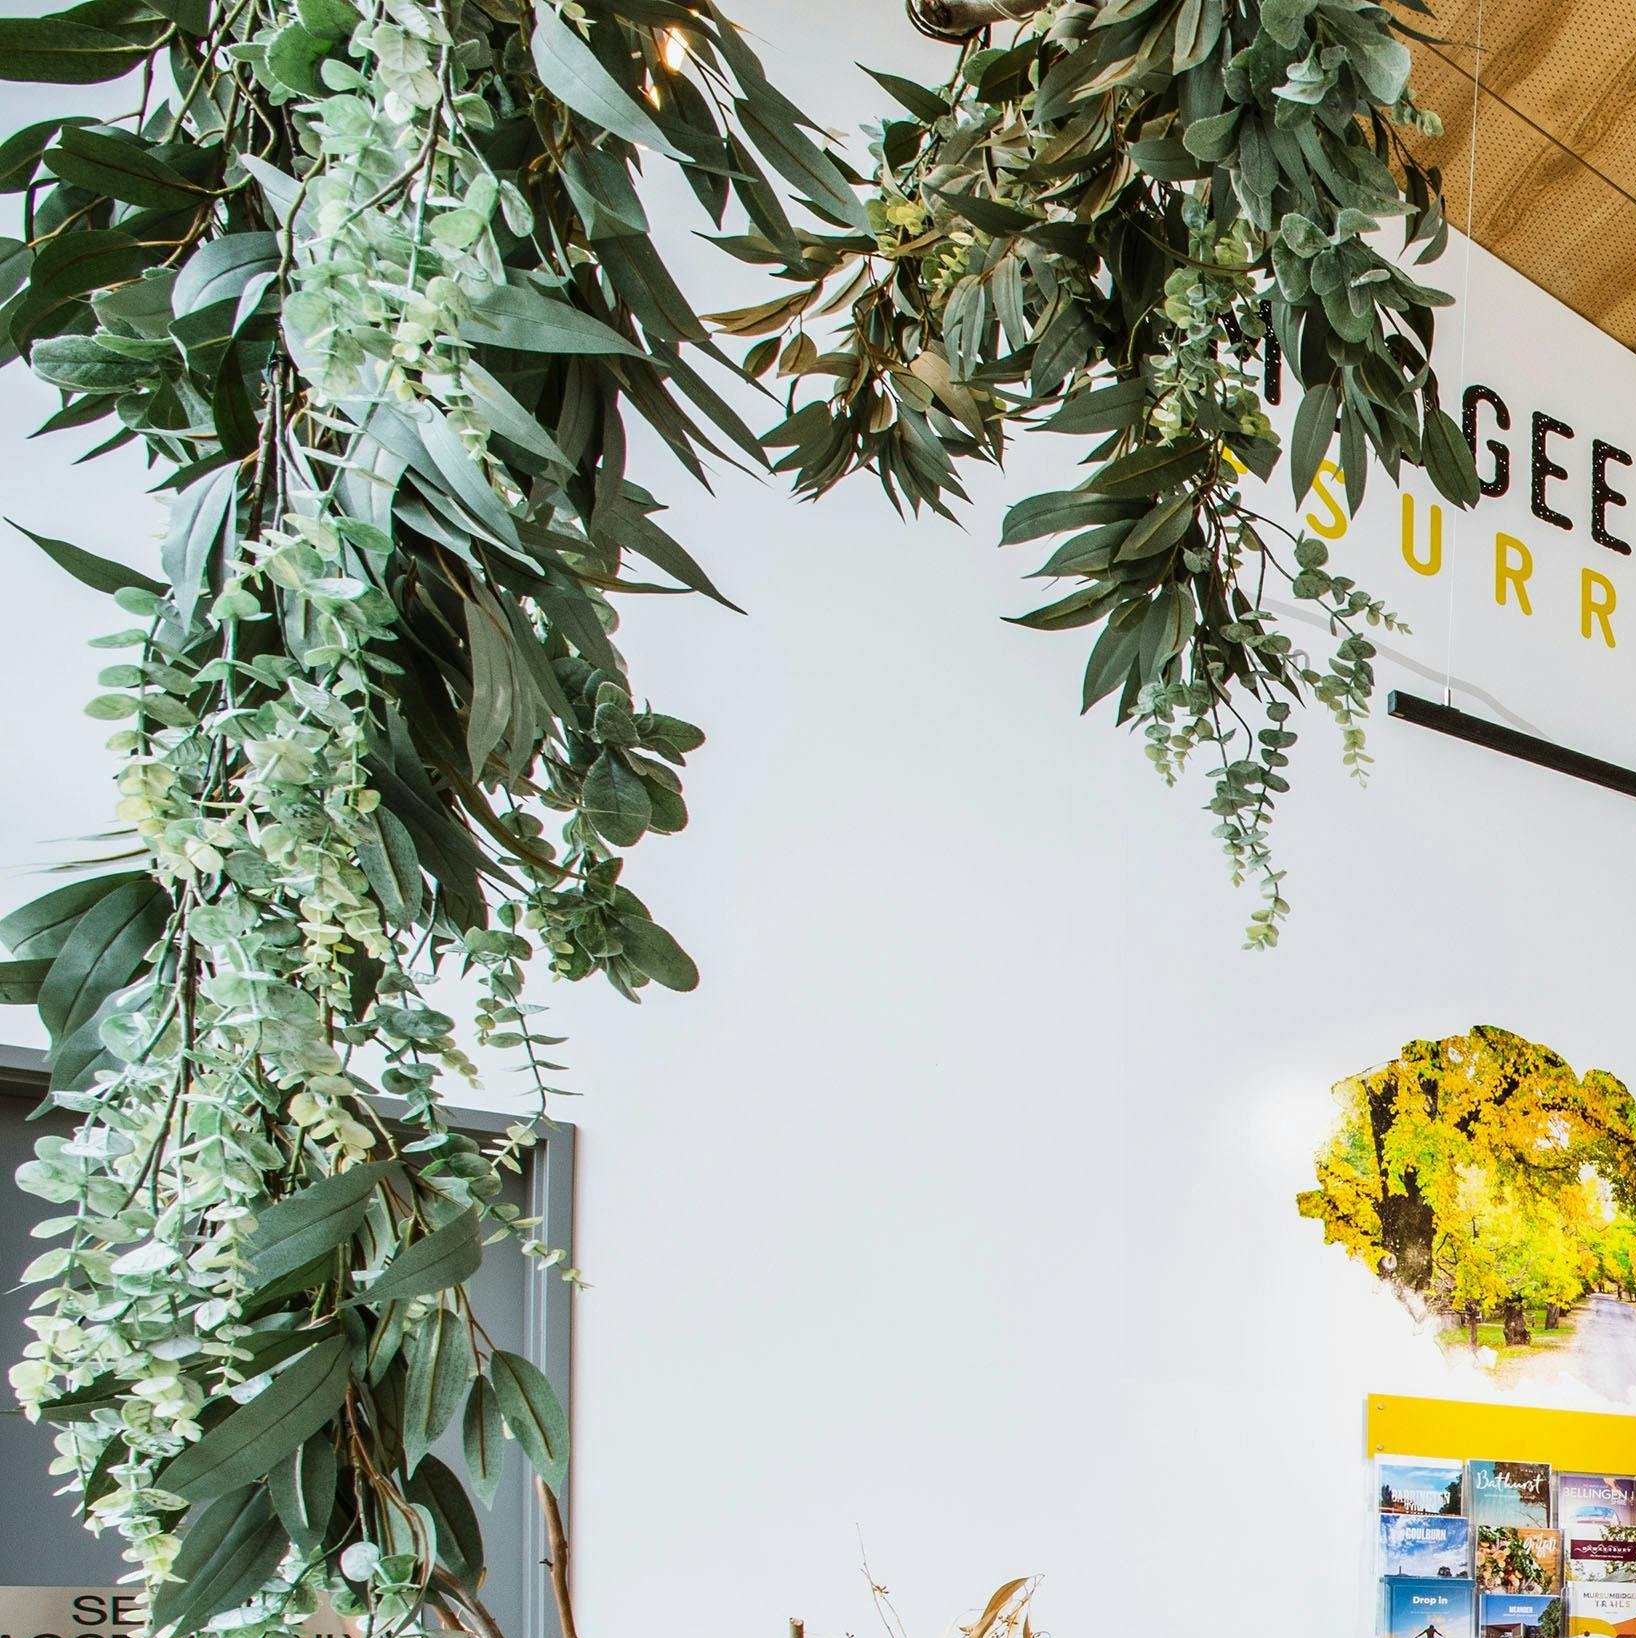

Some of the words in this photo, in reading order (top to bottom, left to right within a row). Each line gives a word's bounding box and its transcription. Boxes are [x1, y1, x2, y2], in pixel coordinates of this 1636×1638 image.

[1476, 1469, 1544, 1493] Bathurst
[1406, 1528, 1446, 1541] GOULBURN
[1412, 1596, 1436, 1606] Drop
[1439, 1596, 1448, 1605] in
[1595, 1600, 1631, 1608] TRAILS
